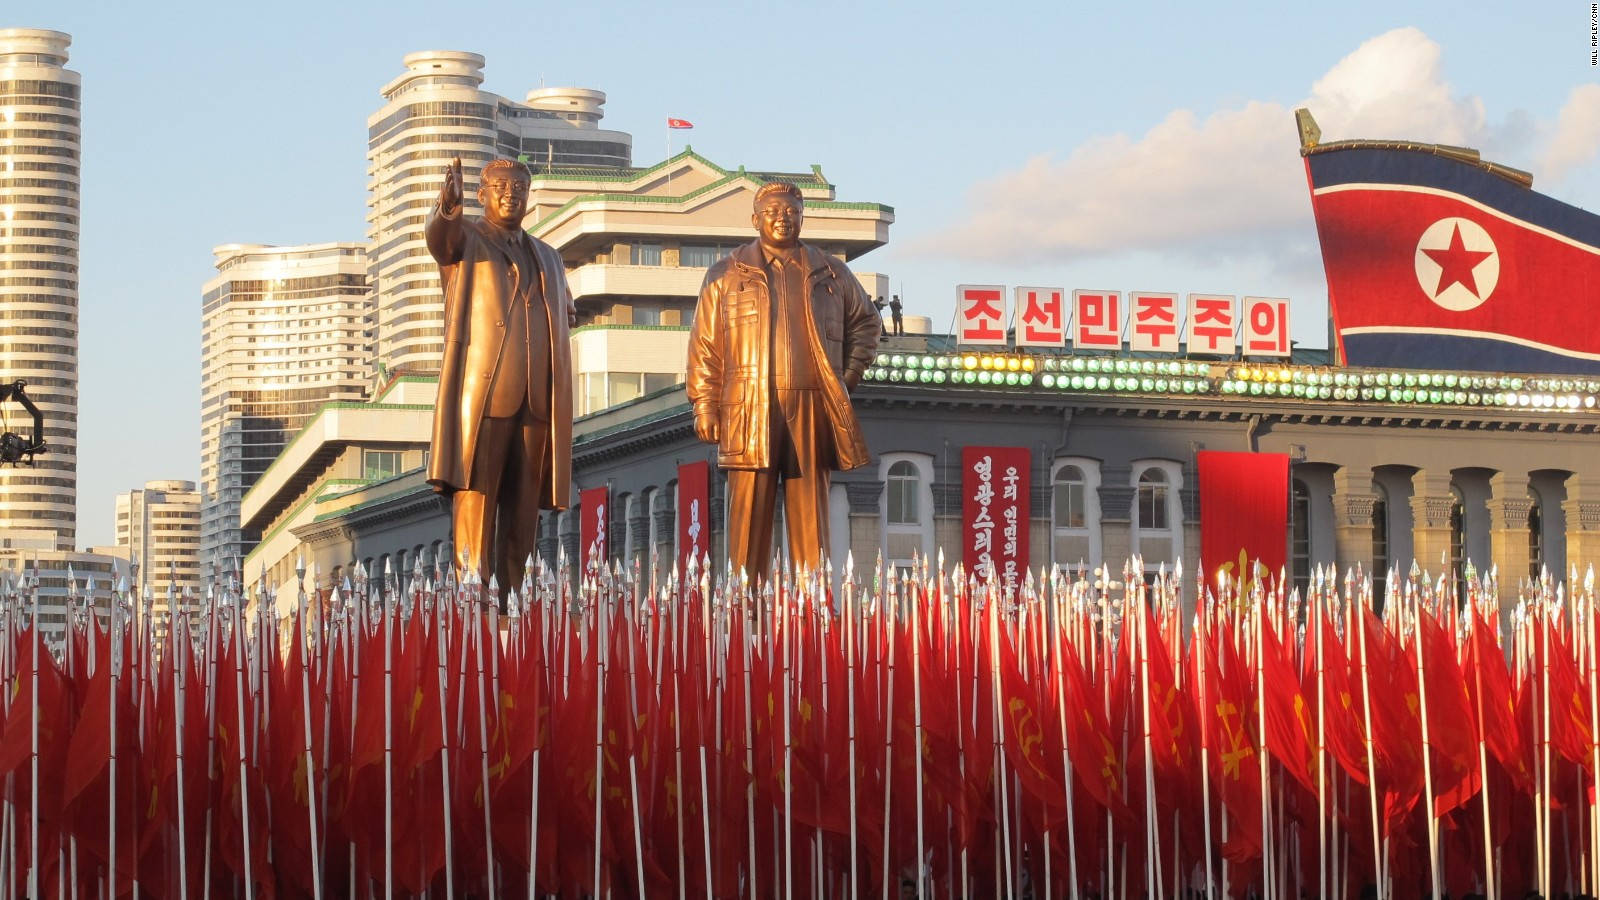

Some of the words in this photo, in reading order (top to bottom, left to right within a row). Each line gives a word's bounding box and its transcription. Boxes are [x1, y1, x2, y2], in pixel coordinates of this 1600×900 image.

[964, 290, 1287, 353] 조선민주주의
[1002, 466, 1019, 501] 우리
[1003, 505, 1017, 557] 인민의
